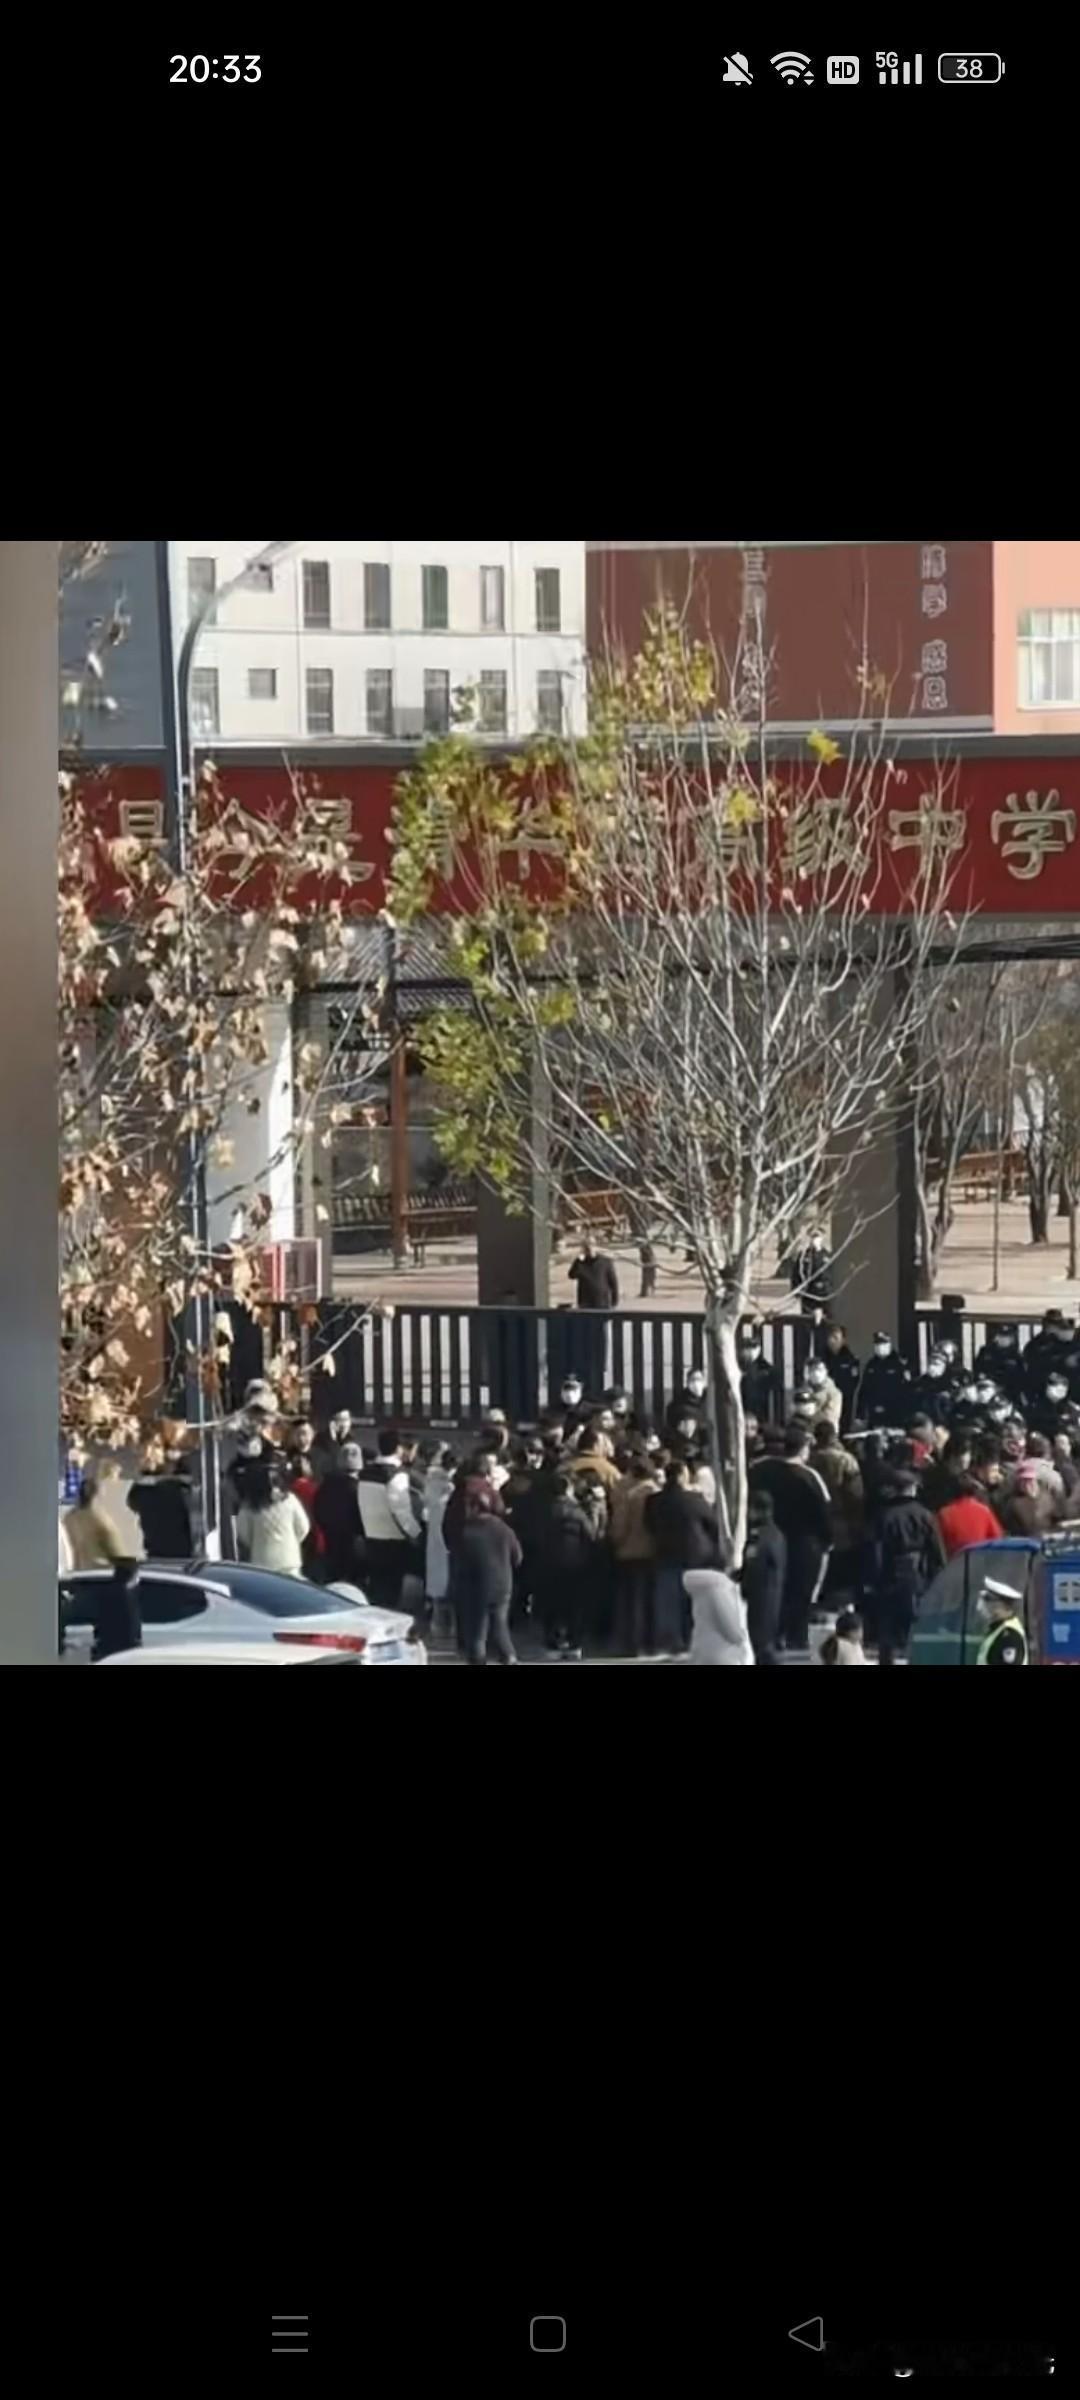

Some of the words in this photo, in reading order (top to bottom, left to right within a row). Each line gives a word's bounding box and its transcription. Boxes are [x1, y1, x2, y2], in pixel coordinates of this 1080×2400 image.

[169, 54, 262, 83] 20:33
[875, 51, 899, 69] 5G
[955, 59, 983, 79] 38
[831, 61, 856, 79] HD
